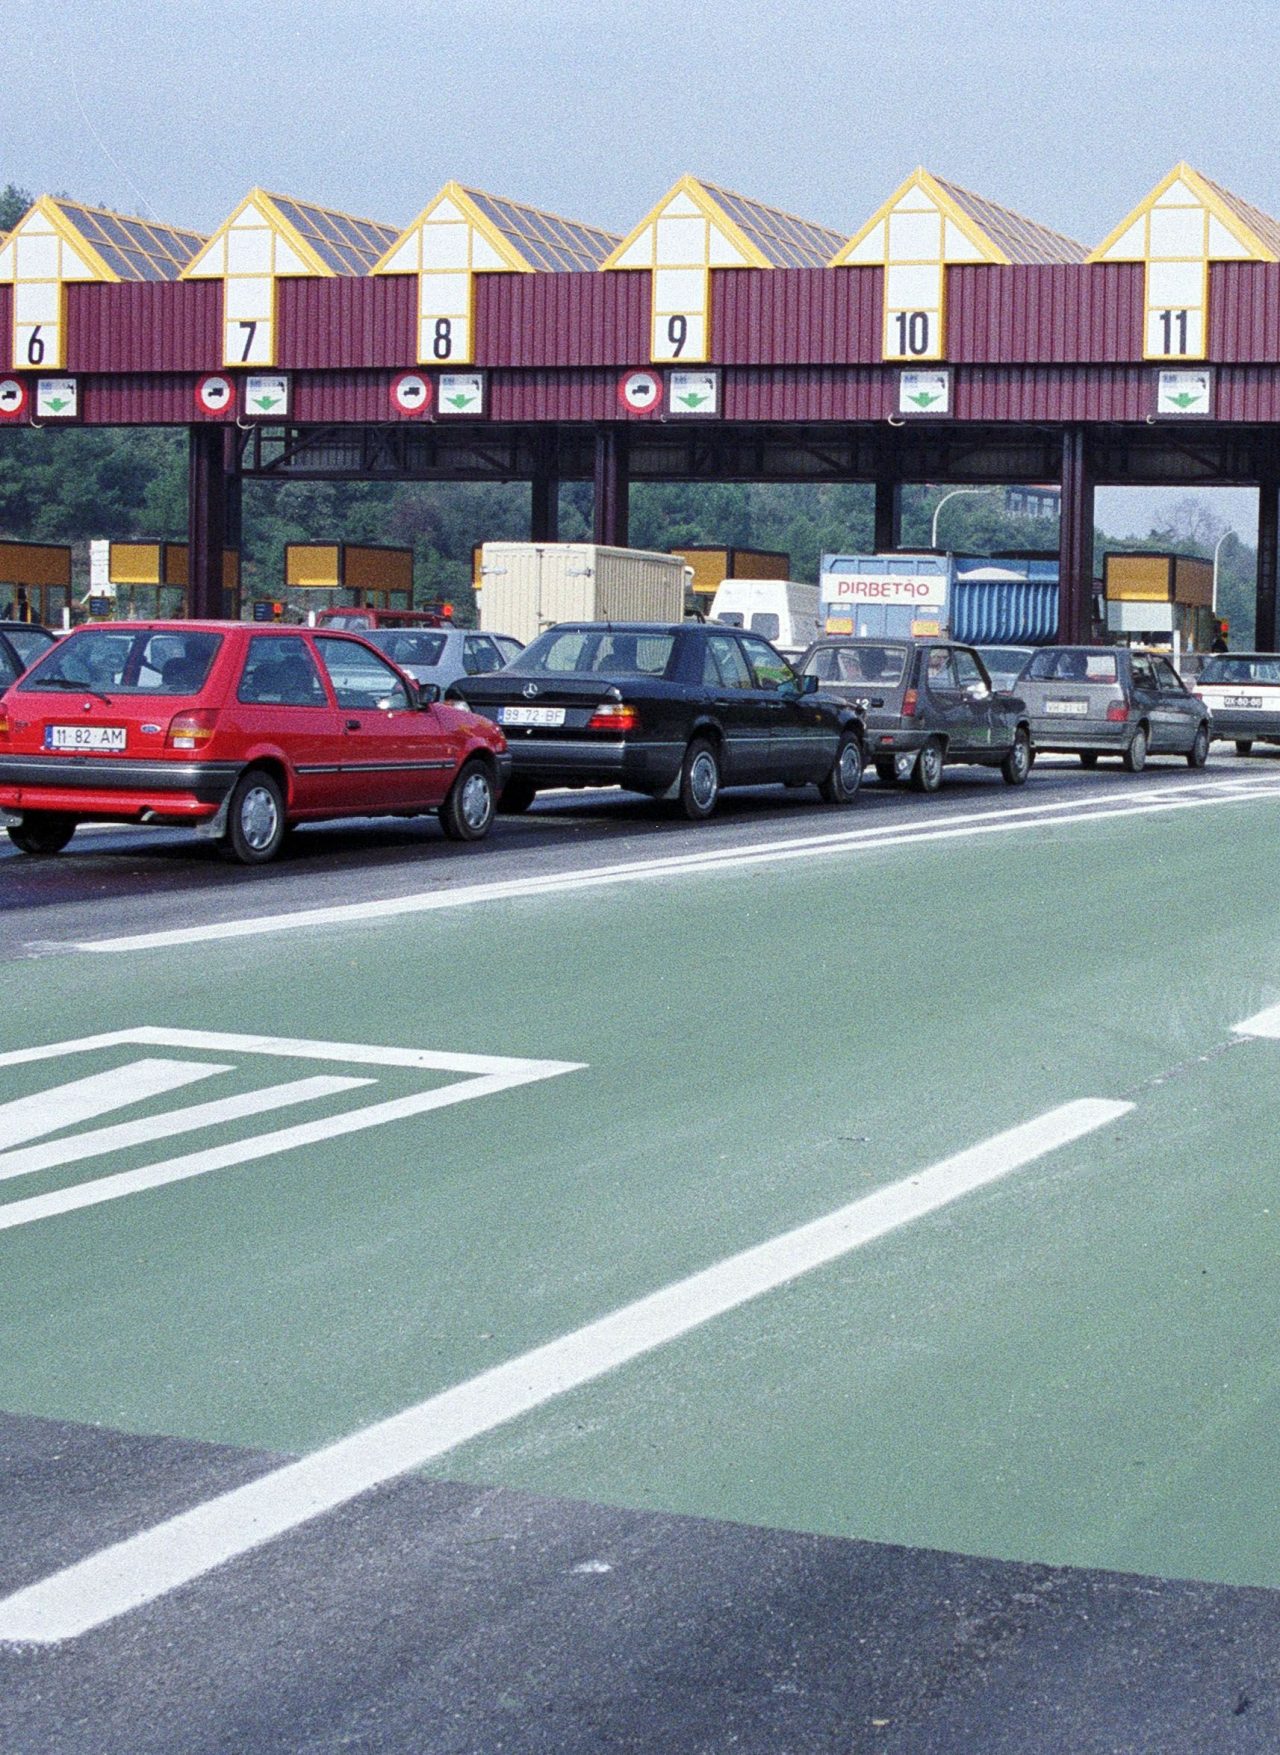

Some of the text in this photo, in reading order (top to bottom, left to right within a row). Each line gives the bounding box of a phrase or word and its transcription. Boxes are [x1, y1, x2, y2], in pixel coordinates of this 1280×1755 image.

[27, 325, 45, 366] 6
[239, 321, 257, 363] 7
[433, 317, 452, 360] 8
[667, 314, 688, 358] 9
[895, 311, 929, 356] 10
[1159, 309, 1188, 355] 11
